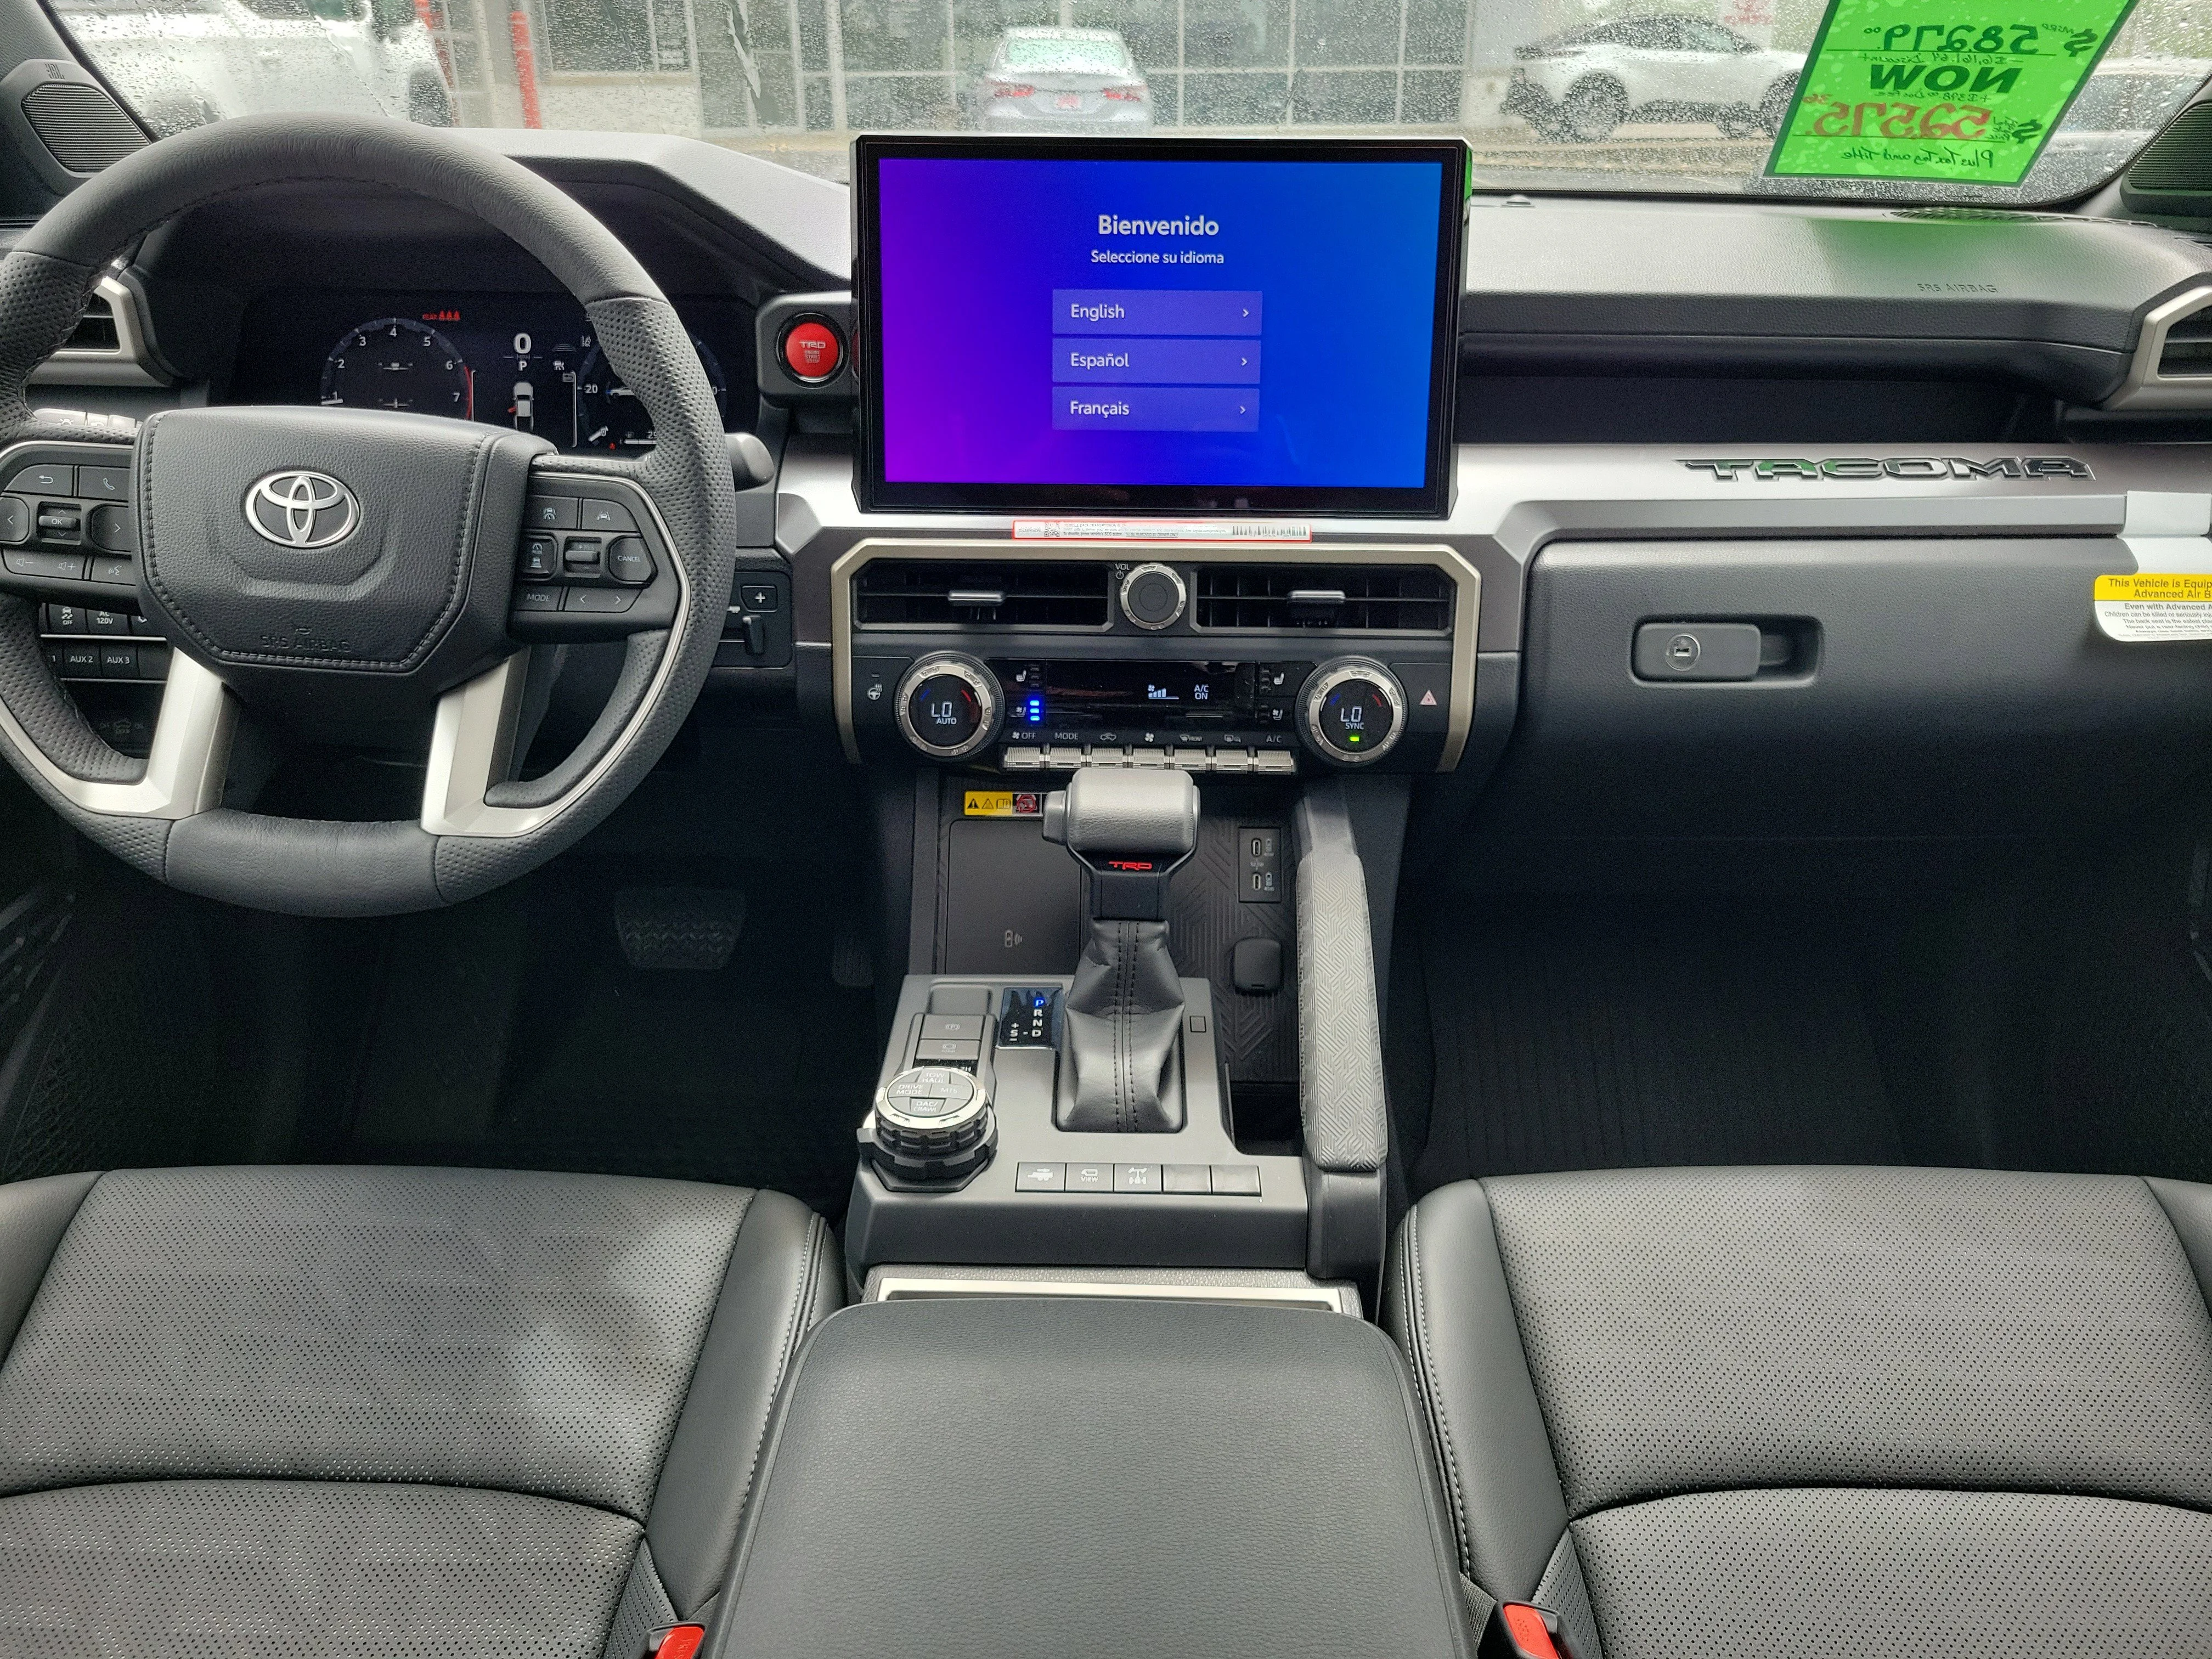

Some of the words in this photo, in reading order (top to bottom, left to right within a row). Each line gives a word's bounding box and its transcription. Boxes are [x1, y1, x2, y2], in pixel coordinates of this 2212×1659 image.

[44, 63, 65, 80] JBL
[1098, 213, 1219, 236] Bienvenido
[1091, 250, 1160, 263] Seleccione
[1163, 253, 1177, 264] su
[1180, 251, 1224, 264] idioma
[1917, 284, 1943, 292] SRS
[1946, 284, 1999, 292] AIRBAG
[1070, 303, 1125, 321] English
[390, 328, 397, 337] 4
[359, 336, 366, 347] 3
[423, 336, 431, 347] 5
[514, 332, 532, 354] 0
[799, 341, 826, 349] TRD
[337, 359, 345, 369] 2
[445, 360, 454, 370] 6
[518, 360, 527, 371] P
[1070, 353, 1130, 370] Español
[584, 383, 598, 393] 20
[453, 392, 460, 402] 7
[1070, 400, 1130, 418] Français
[1672, 456, 2096, 482] TACOMA
[2108, 578, 2129, 587] This
[2134, 579, 2169, 587] Vehicle
[527, 593, 550, 602] MODE
[2134, 590, 2183, 599] Advanced
[1194, 684, 1209, 693] A/C
[1054, 732, 1079, 741] MODE
[1108, 861, 1153, 871] TRD
[1034, 998, 1045, 1007] P
[1033, 1009, 1043, 1017] R
[1031, 1029, 1042, 1037] D
